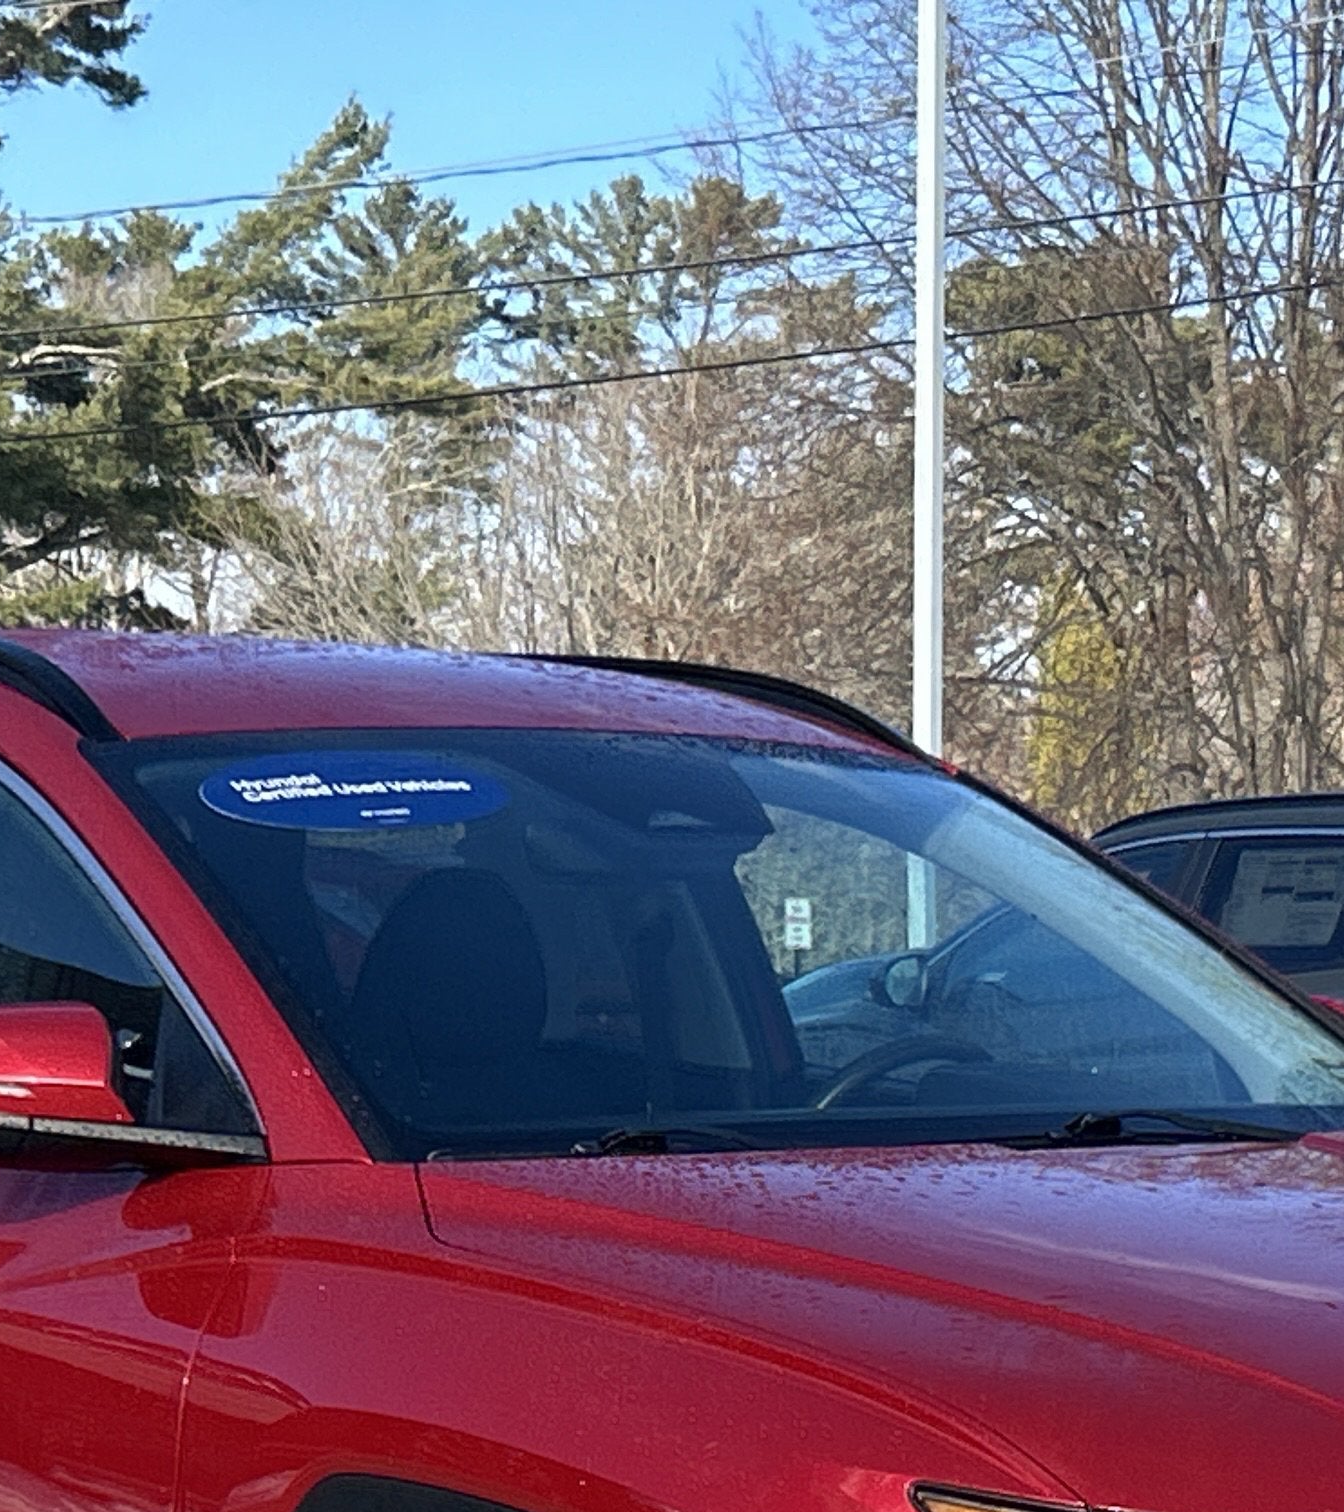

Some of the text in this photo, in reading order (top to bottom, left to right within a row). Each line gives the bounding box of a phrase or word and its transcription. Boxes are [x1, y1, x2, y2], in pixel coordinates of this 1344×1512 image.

[230, 774, 321, 791] Hyundai
[242, 780, 471, 803] Certified Used Vehicles
